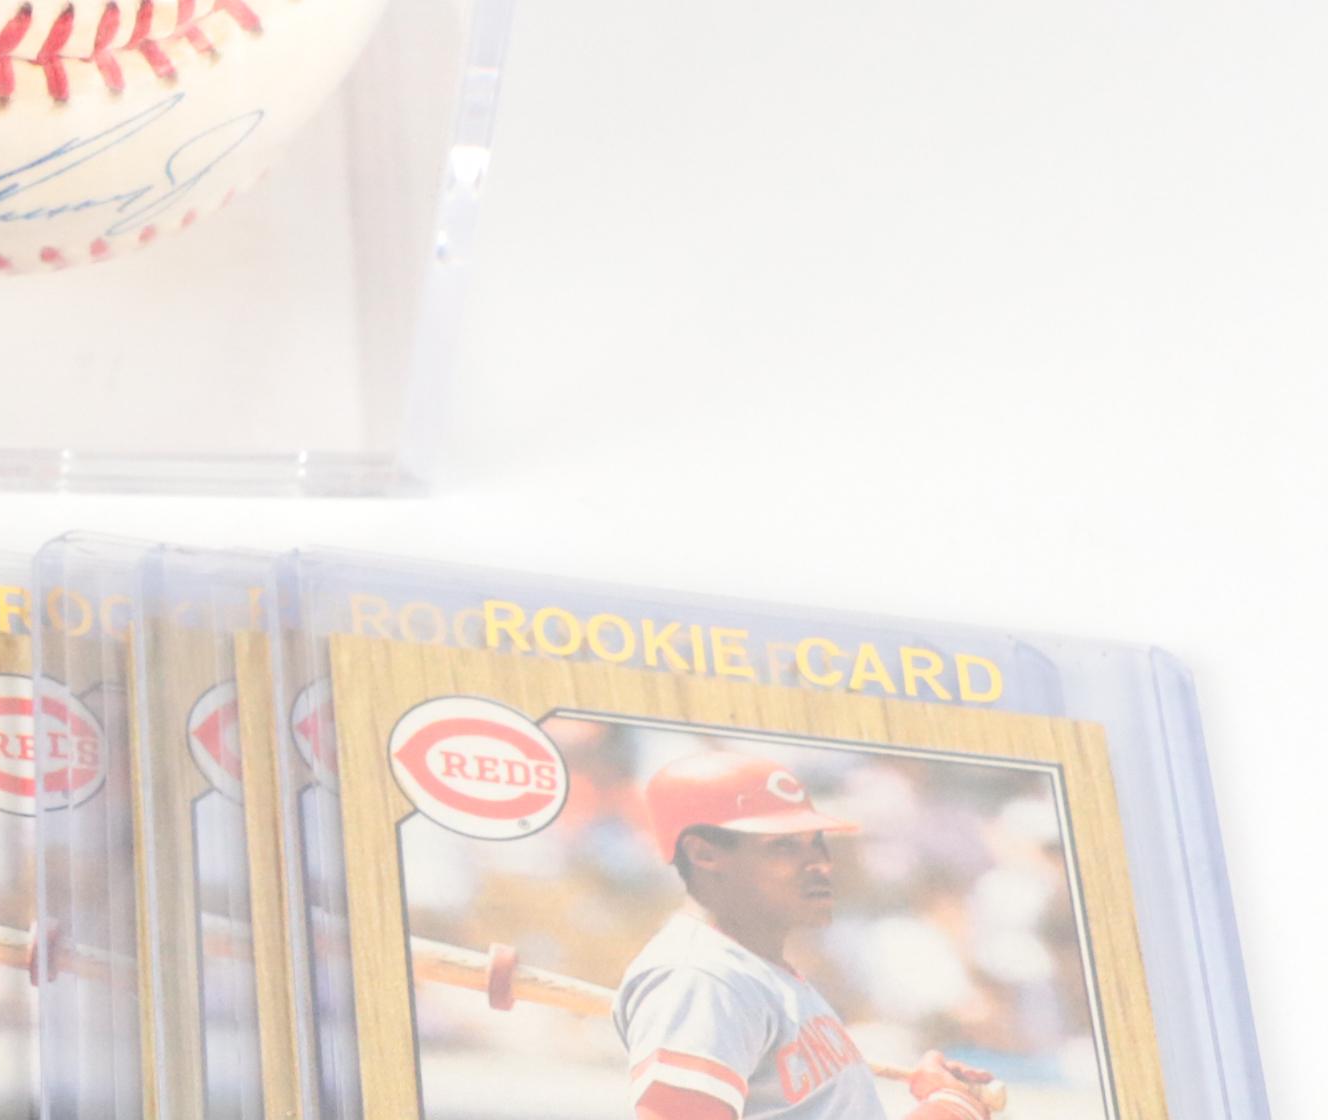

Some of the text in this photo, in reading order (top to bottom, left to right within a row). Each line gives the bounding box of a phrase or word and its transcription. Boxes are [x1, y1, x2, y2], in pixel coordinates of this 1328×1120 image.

[482, 599, 752, 678] ROOKIE
[794, 636, 1005, 704] CARD
[438, 749, 557, 792] REDS
